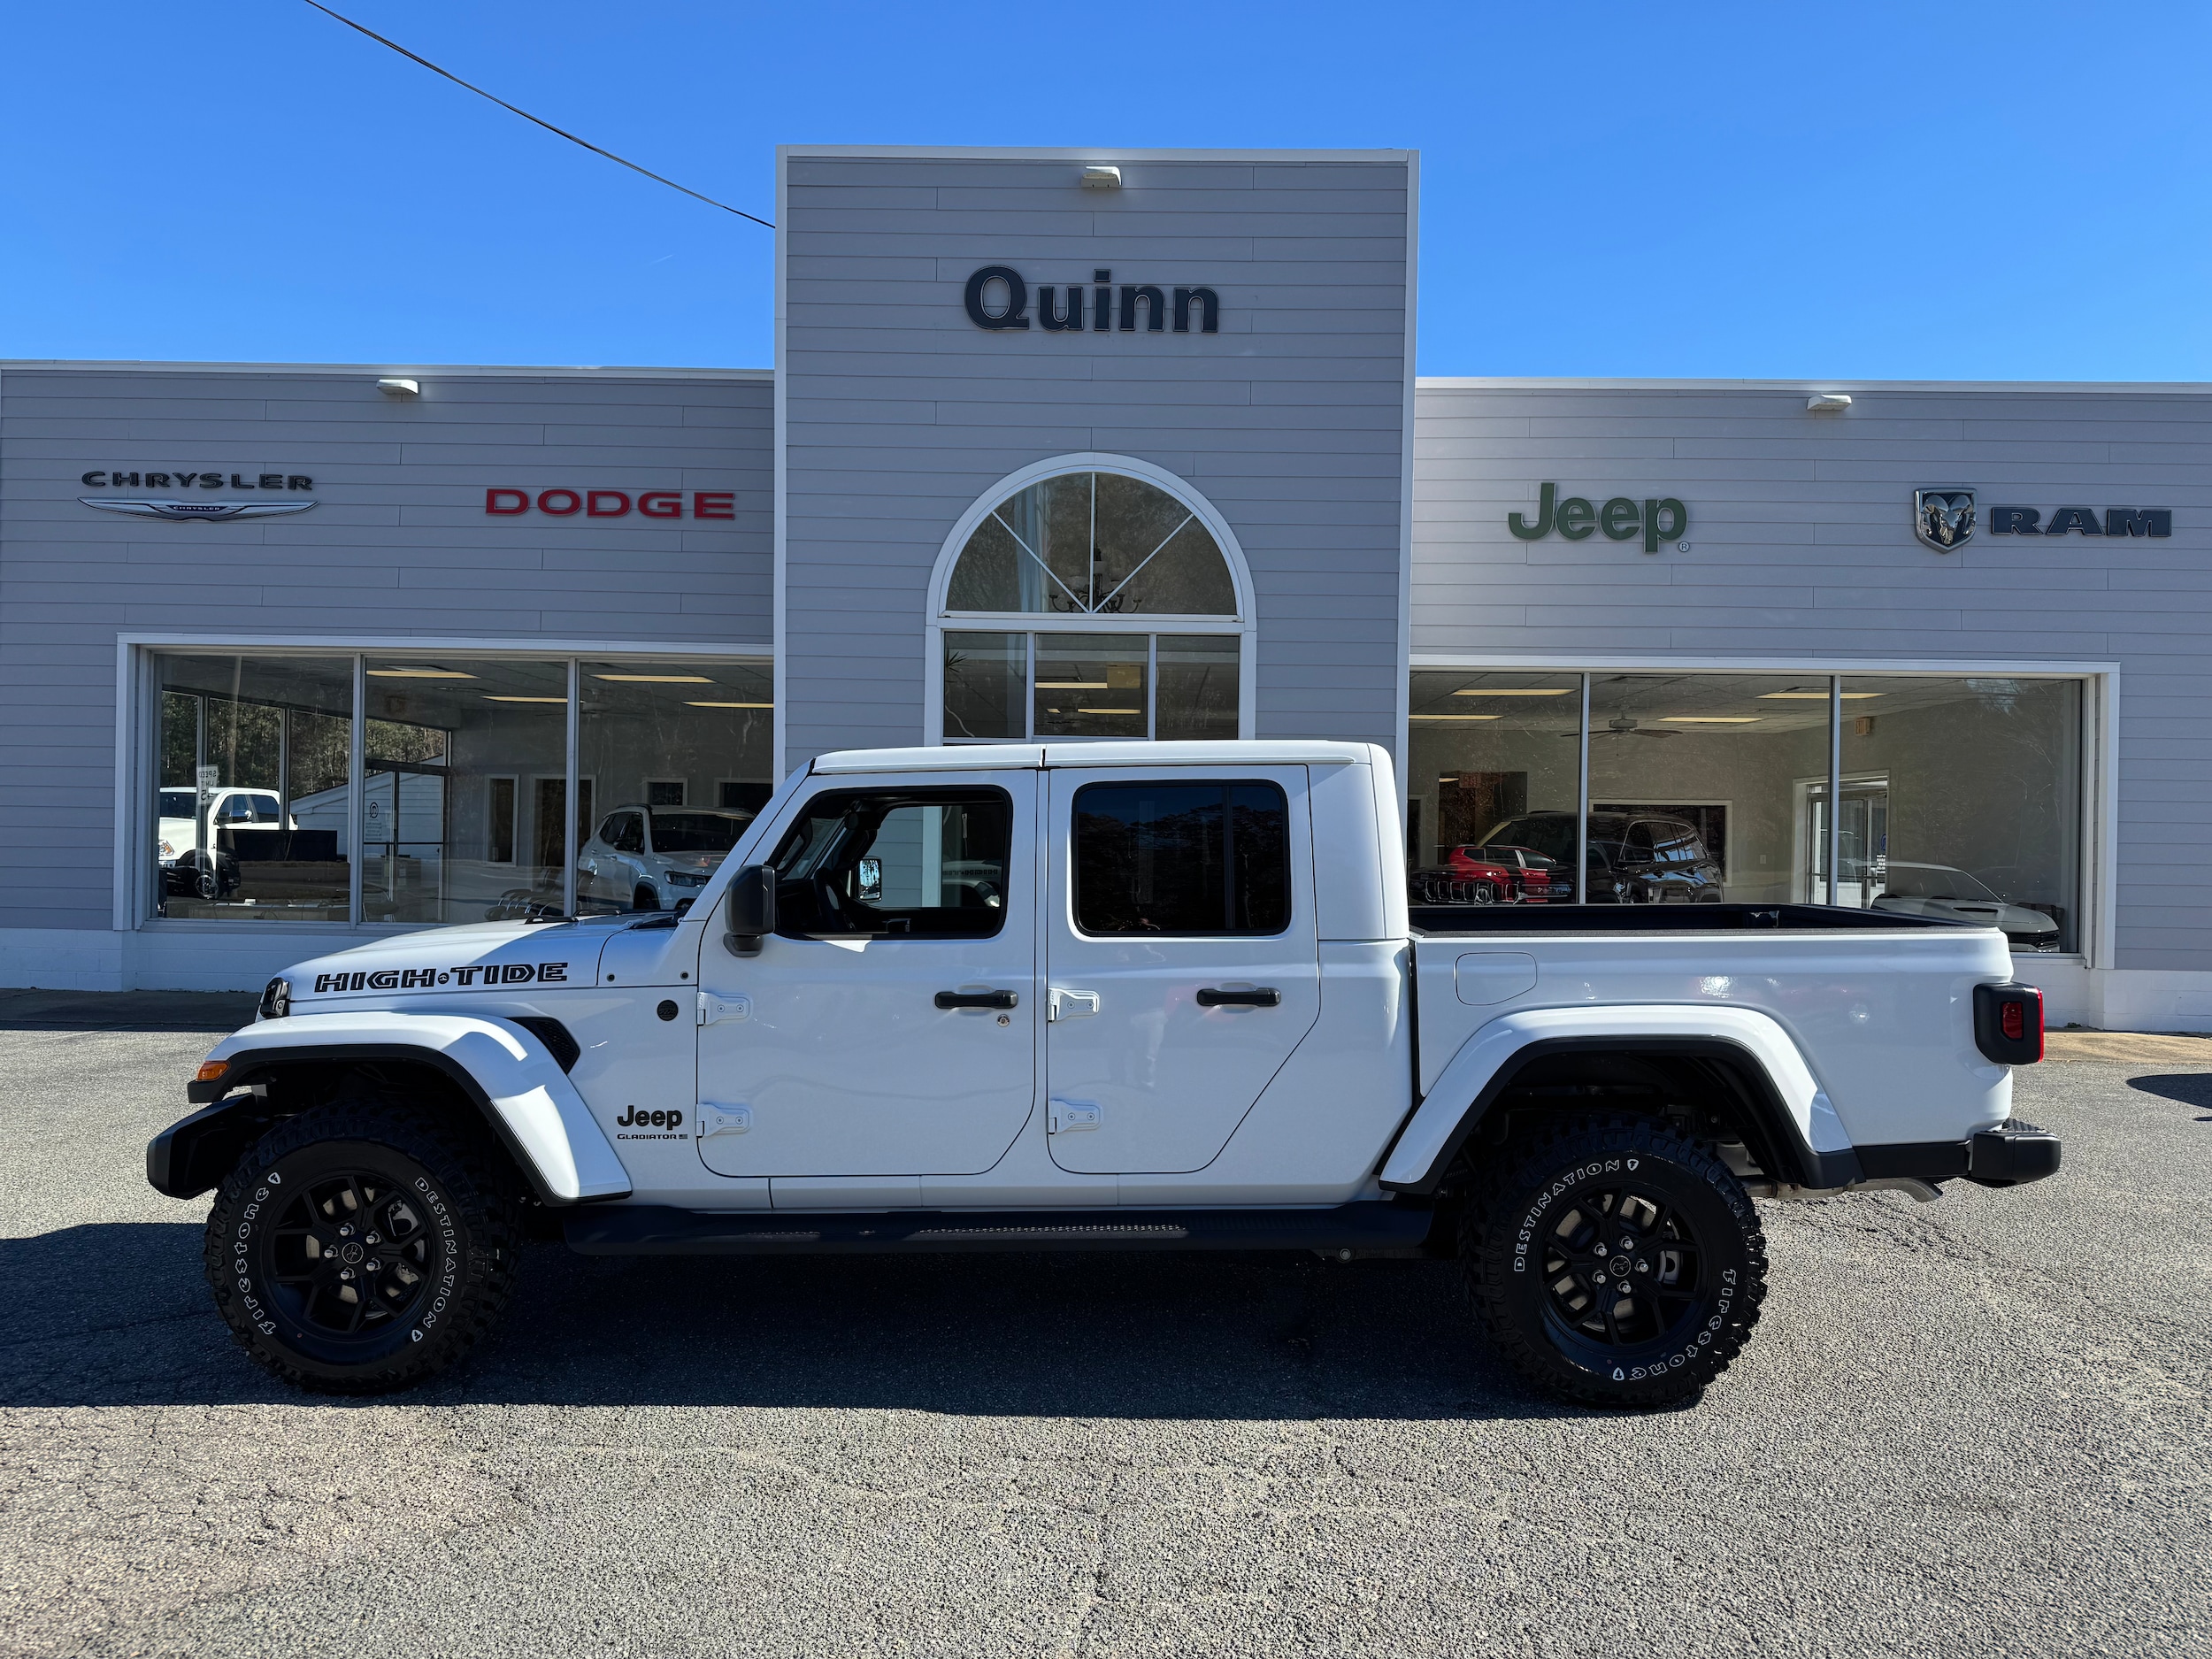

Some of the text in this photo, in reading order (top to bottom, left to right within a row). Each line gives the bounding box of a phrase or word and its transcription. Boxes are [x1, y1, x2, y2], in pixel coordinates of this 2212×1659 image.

[964, 265, 1219, 333] Quinn
[81, 471, 312, 490] CHRYSLER
[486, 488, 734, 521] DODGE
[1508, 481, 1688, 554] Jeep
[1991, 506, 2172, 538] RAM
[314, 962, 569, 993] HIGH TIDE
[617, 1105, 682, 1131] Jeep
[1514, 1159, 1620, 1272] DESTINATION
[415, 1177, 457, 1329] DESTINATION
